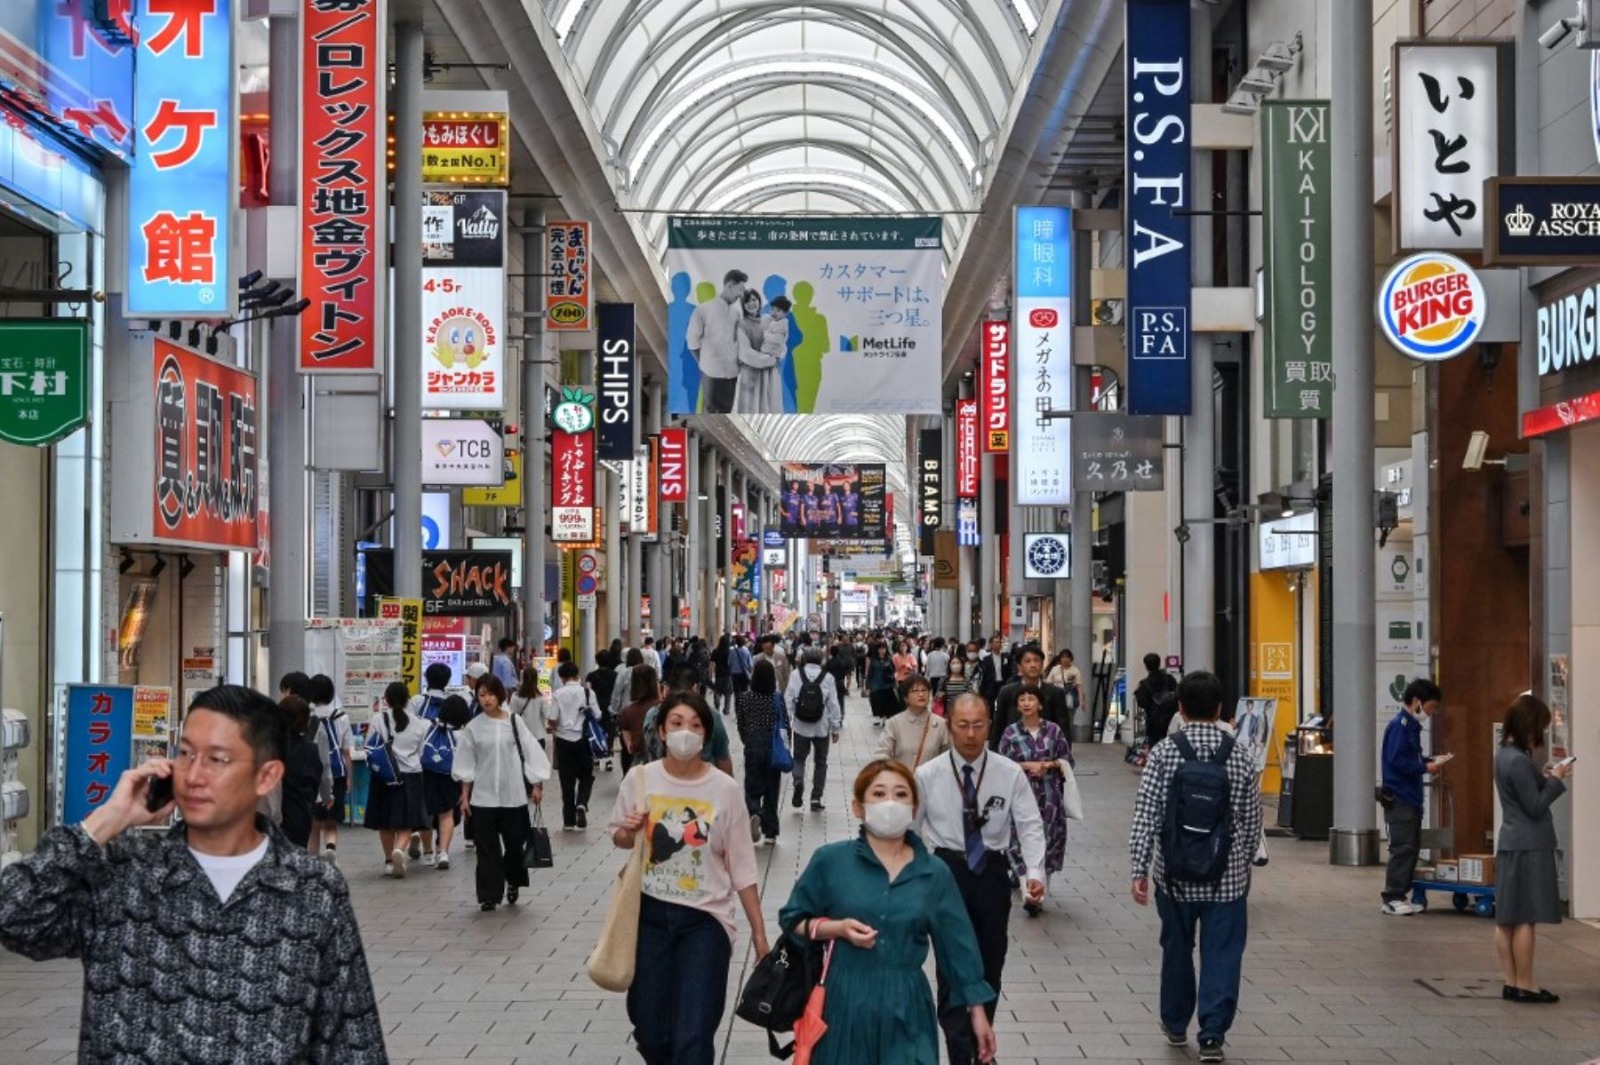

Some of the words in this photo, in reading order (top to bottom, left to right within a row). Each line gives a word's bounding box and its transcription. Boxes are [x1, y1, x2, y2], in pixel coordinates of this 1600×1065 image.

[423, 124, 495, 145] もみほぐし
[1418, 72, 1476, 237] いとや
[820, 262, 907, 280] カスタマー
[1299, 150, 1316, 355] KAITOLOGY
[1394, 273, 1469, 310] BURGER
[1398, 290, 1474, 335] KING
[863, 336, 916, 349] MetLife
[1142, 313, 1180, 332] P.S.
[1537, 283, 1600, 376] BURG
[427, 371, 495, 386] ジャンカラ
[603, 339, 629, 424] SHIPS
[990, 325, 1007, 429] サンドラッグ
[1036, 332, 1052, 432] メガネの田中
[1285, 361, 1331, 382] 買取
[1300, 390, 1320, 410] 質
[457, 440, 491, 458] TCB
[560, 450, 572, 505] バイキング
[924, 459, 938, 526] BEAMS
[432, 559, 509, 606] SHACK
[425, 601, 444, 613] 5F
[84, 692, 113, 819] カラオケ
